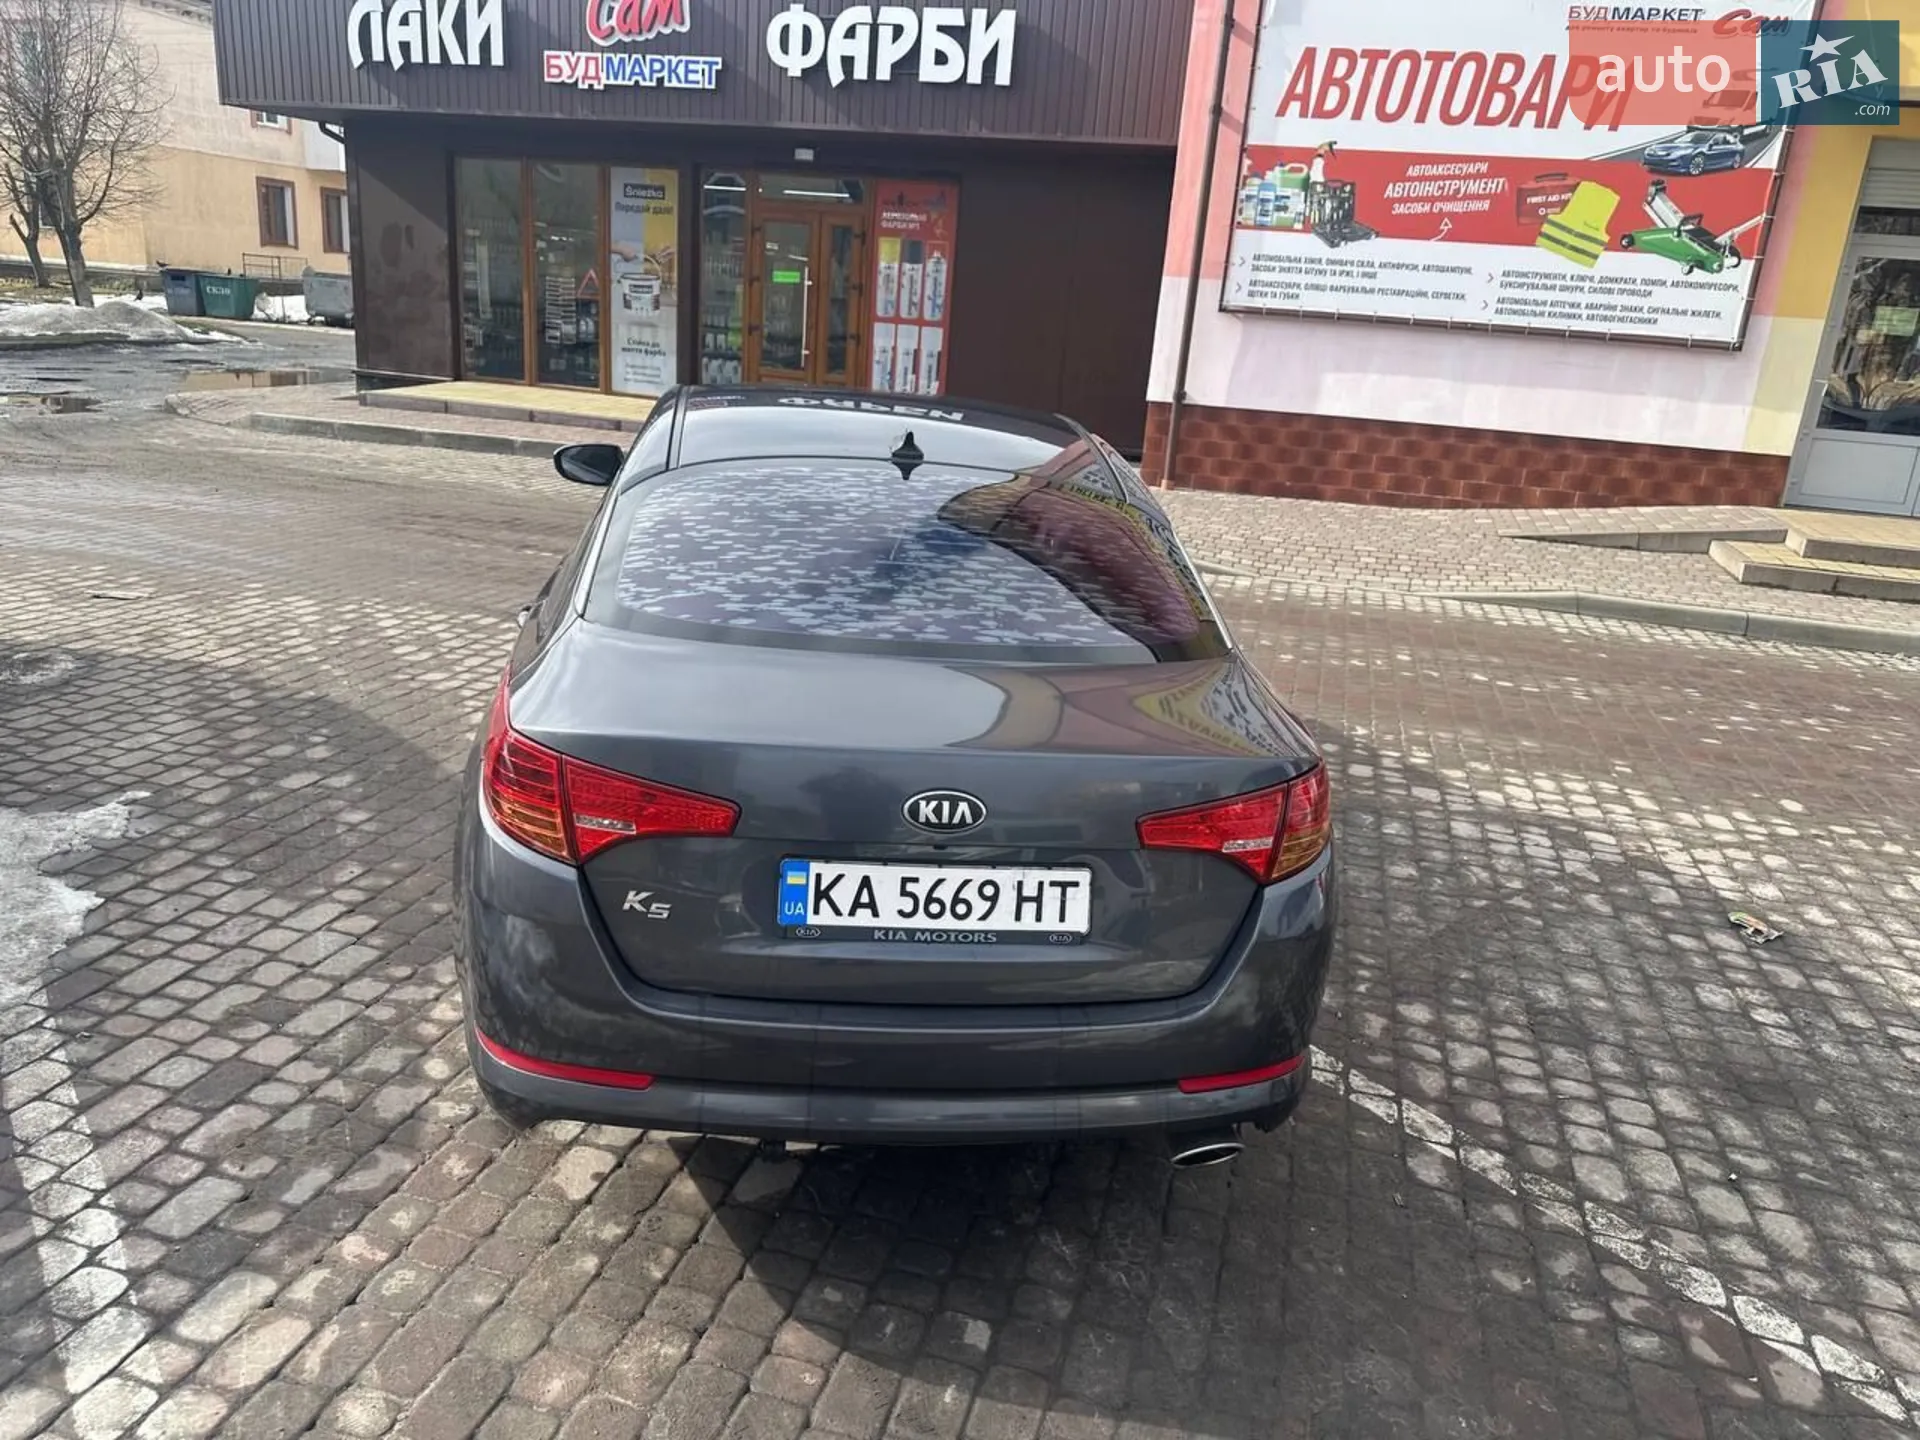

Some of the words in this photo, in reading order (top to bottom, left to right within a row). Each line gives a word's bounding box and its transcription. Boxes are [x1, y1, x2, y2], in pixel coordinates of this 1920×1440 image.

[1568, 5, 1703, 23] БУДМАРКЕТ
[347, 0, 505, 71] ЛАКИ
[766, 3, 1017, 88] ФАРБИ
[544, 53, 720, 88] БУДМАРКЕТ
[1275, 46, 1635, 133] АВТОТОВАРИ
[1405, 162, 1489, 177] АВТОАКСЕСУАРИ
[1383, 177, 1506, 199] АВТОІНСТРУМЕНТ
[1526, 195, 1547, 204] FIRST
[1391, 202, 1432, 215] ЗАСОБИ
[1432, 199, 1491, 213] ОЧИЩЕННЯ
[918, 800, 973, 824] KIA
[622, 890, 672, 919] K5
[784, 902, 805, 915] UA
[812, 872, 880, 918] KA
[897, 876, 1000, 921] 5669
[1014, 880, 1080, 923] HT
[873, 929, 908, 941] KIA
[914, 930, 997, 943] MOTORS
